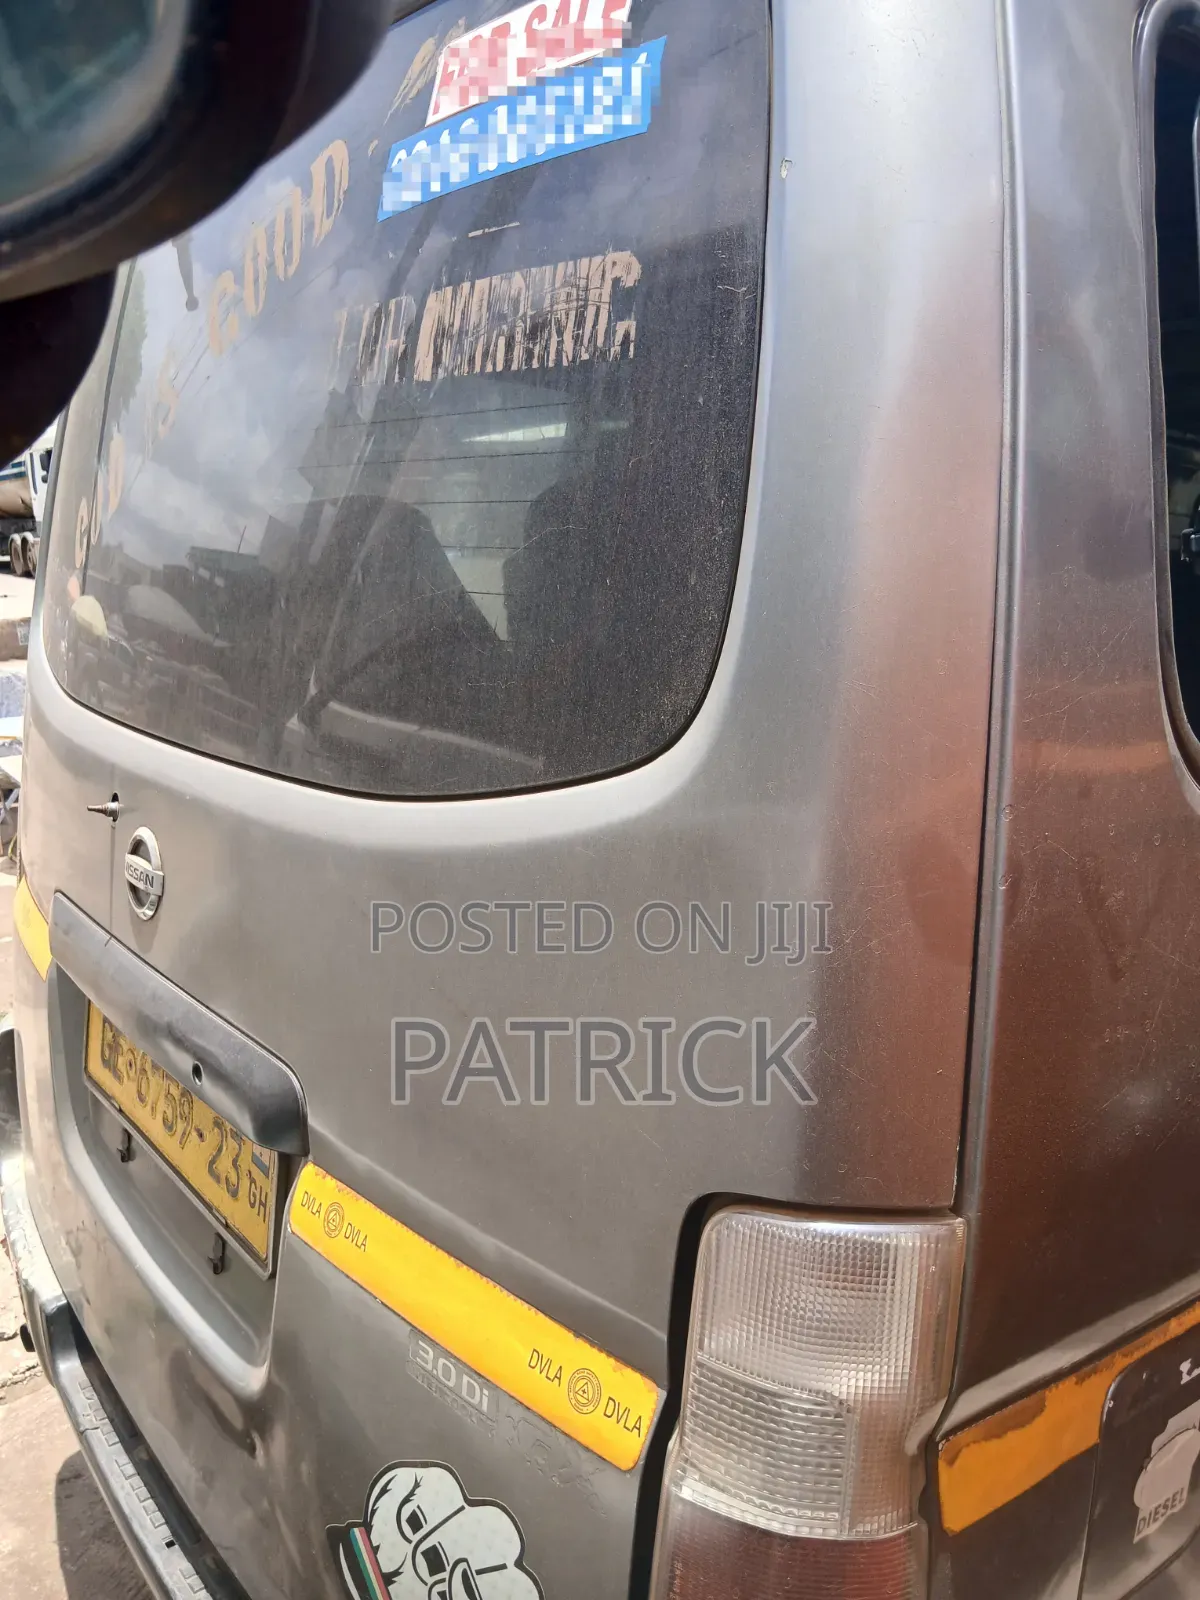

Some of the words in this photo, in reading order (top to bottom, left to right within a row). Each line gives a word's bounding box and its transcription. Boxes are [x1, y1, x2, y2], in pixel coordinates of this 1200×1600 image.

[248, 1182, 268, 1223] GH
[301, 1191, 322, 1218] DVLA
[344, 1222, 367, 1252] DVLA
[528, 1348, 563, 1387] DVLA
[603, 1396, 643, 1438] DVLA
[1136, 1488, 1185, 1536] DIESEL
